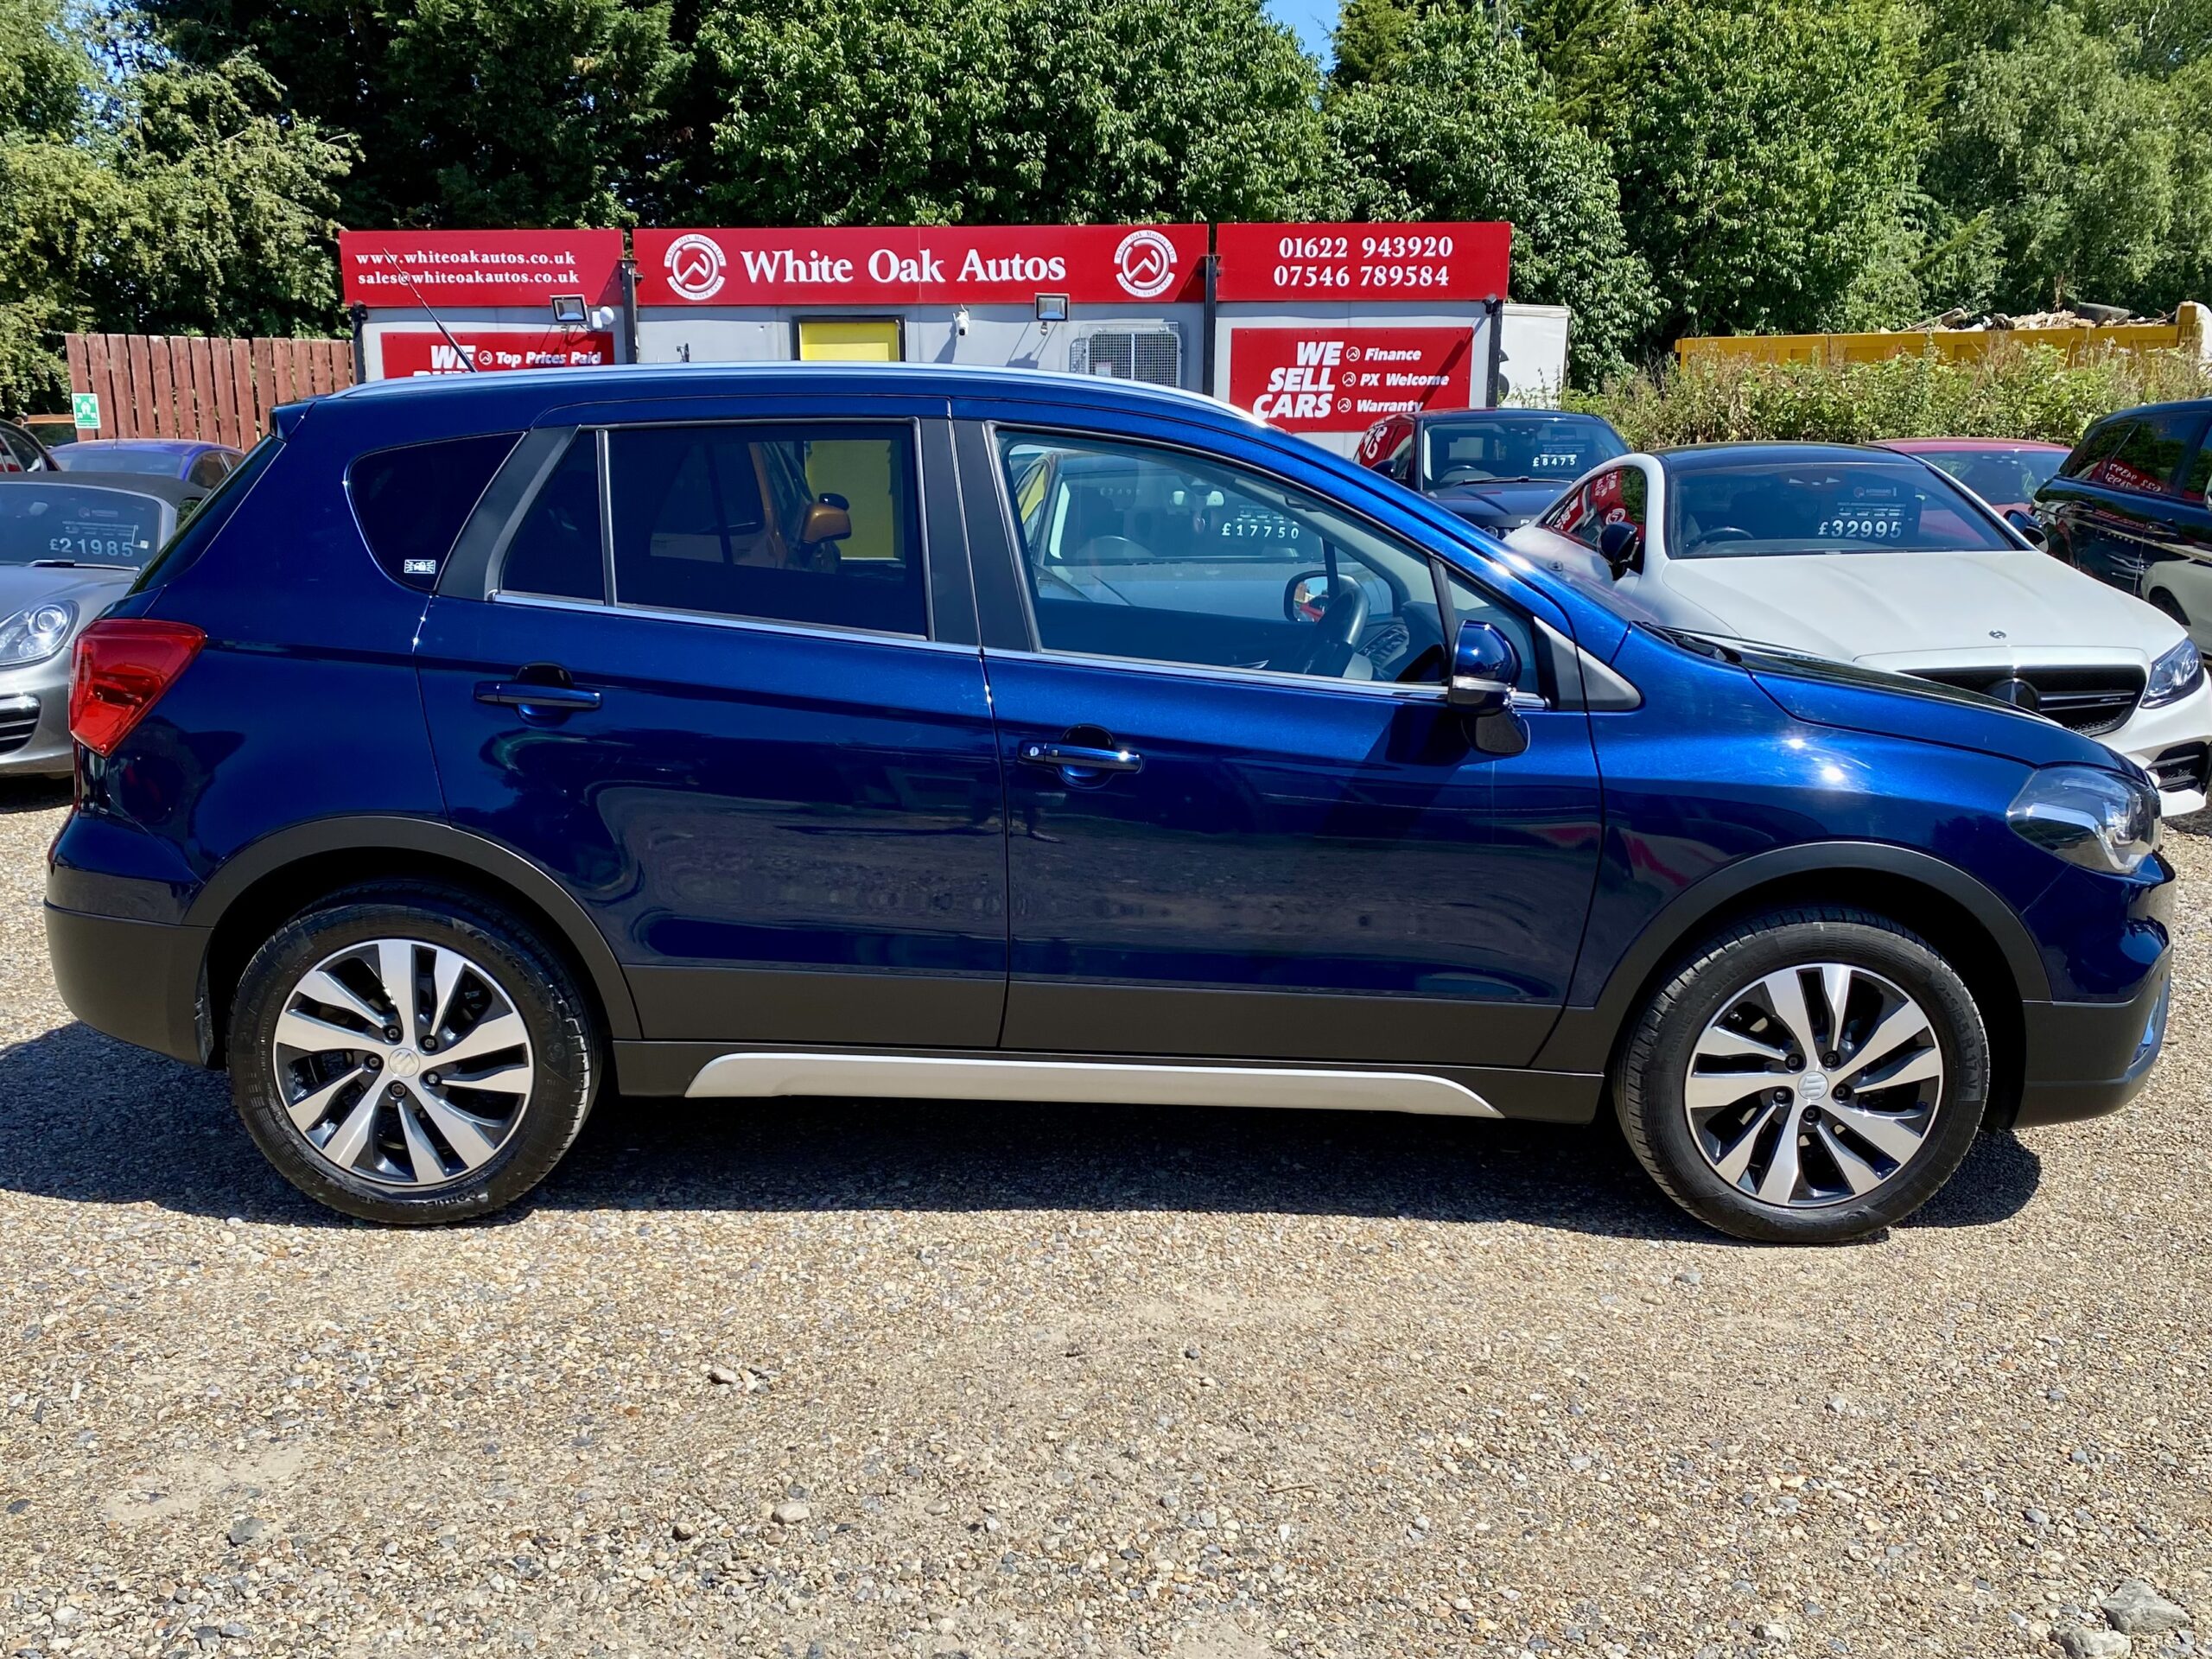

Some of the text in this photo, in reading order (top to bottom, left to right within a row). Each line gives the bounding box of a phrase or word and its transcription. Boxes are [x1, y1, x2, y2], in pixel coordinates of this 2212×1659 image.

[1147, 232, 1166, 244] Motors
[1279, 236, 1453, 258] 01622 943920
[355, 250, 576, 265] www.whiteoakautos.co.uk
[741, 248, 1066, 283] White Oak Autos
[358, 270, 580, 286] sales@whiteoakautos.co.uk
[1274, 265, 1449, 287] 07546 789584
[430, 345, 476, 369] WE
[495, 351, 602, 367] Top Prices Paid
[1296, 340, 1344, 366] WE
[1364, 347, 1422, 361] Finance
[1267, 366, 1336, 392] SELL
[1359, 372, 1450, 387] PX Welcome
[1252, 393, 1334, 419] CARS
[1357, 398, 1424, 414] Warranty
[1532, 456, 1576, 467] £8475
[1221, 522, 1300, 539] £17750
[1818, 519, 1902, 539] £32995
[49, 537, 134, 557] £21985
